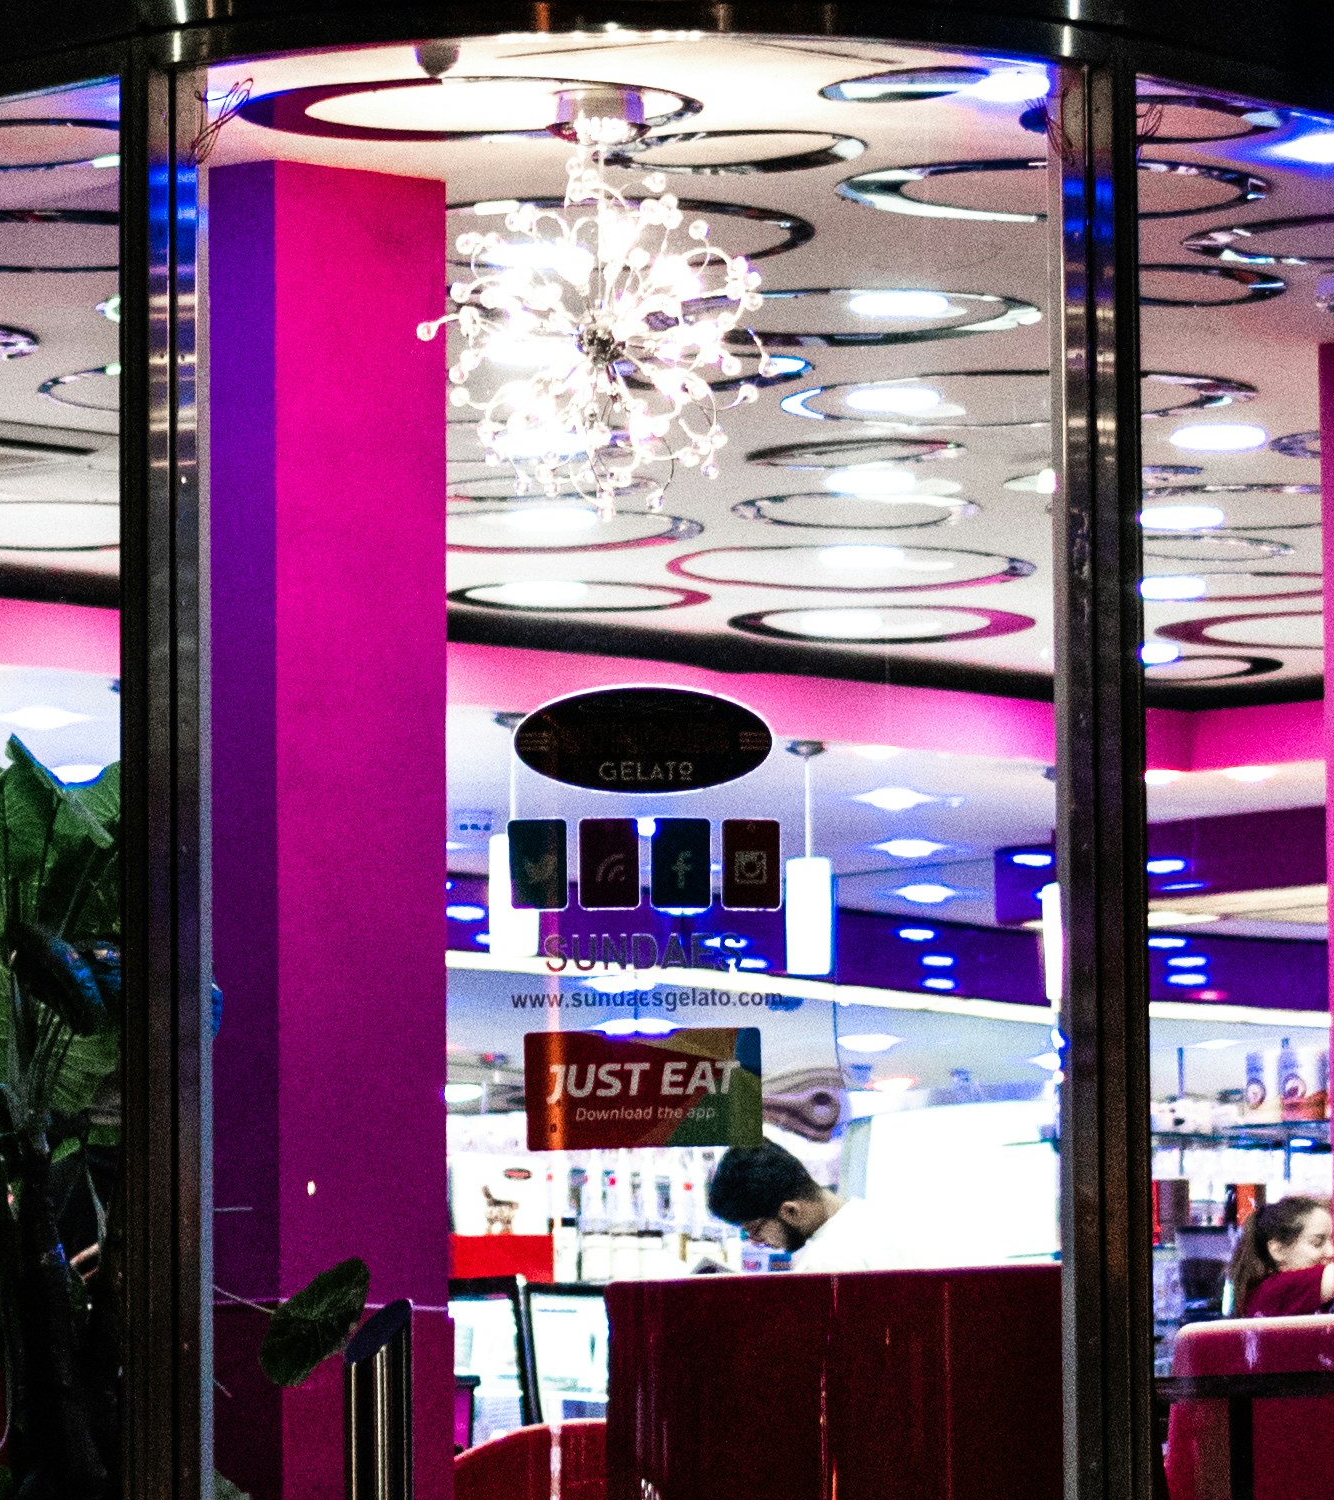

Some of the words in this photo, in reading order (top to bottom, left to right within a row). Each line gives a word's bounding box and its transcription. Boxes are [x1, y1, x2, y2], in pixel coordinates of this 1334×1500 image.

[599, 761, 693, 782] GELATO
[544, 933, 743, 972] SUNDAES
[511, 989, 783, 1011] www.sundaesgelato.com
[546, 1063, 650, 1104] JUST
[660, 1060, 740, 1095] EAT
[575, 1106, 652, 1121] Download
[656, 1106, 682, 1119] the
[687, 1107, 716, 1121] app
